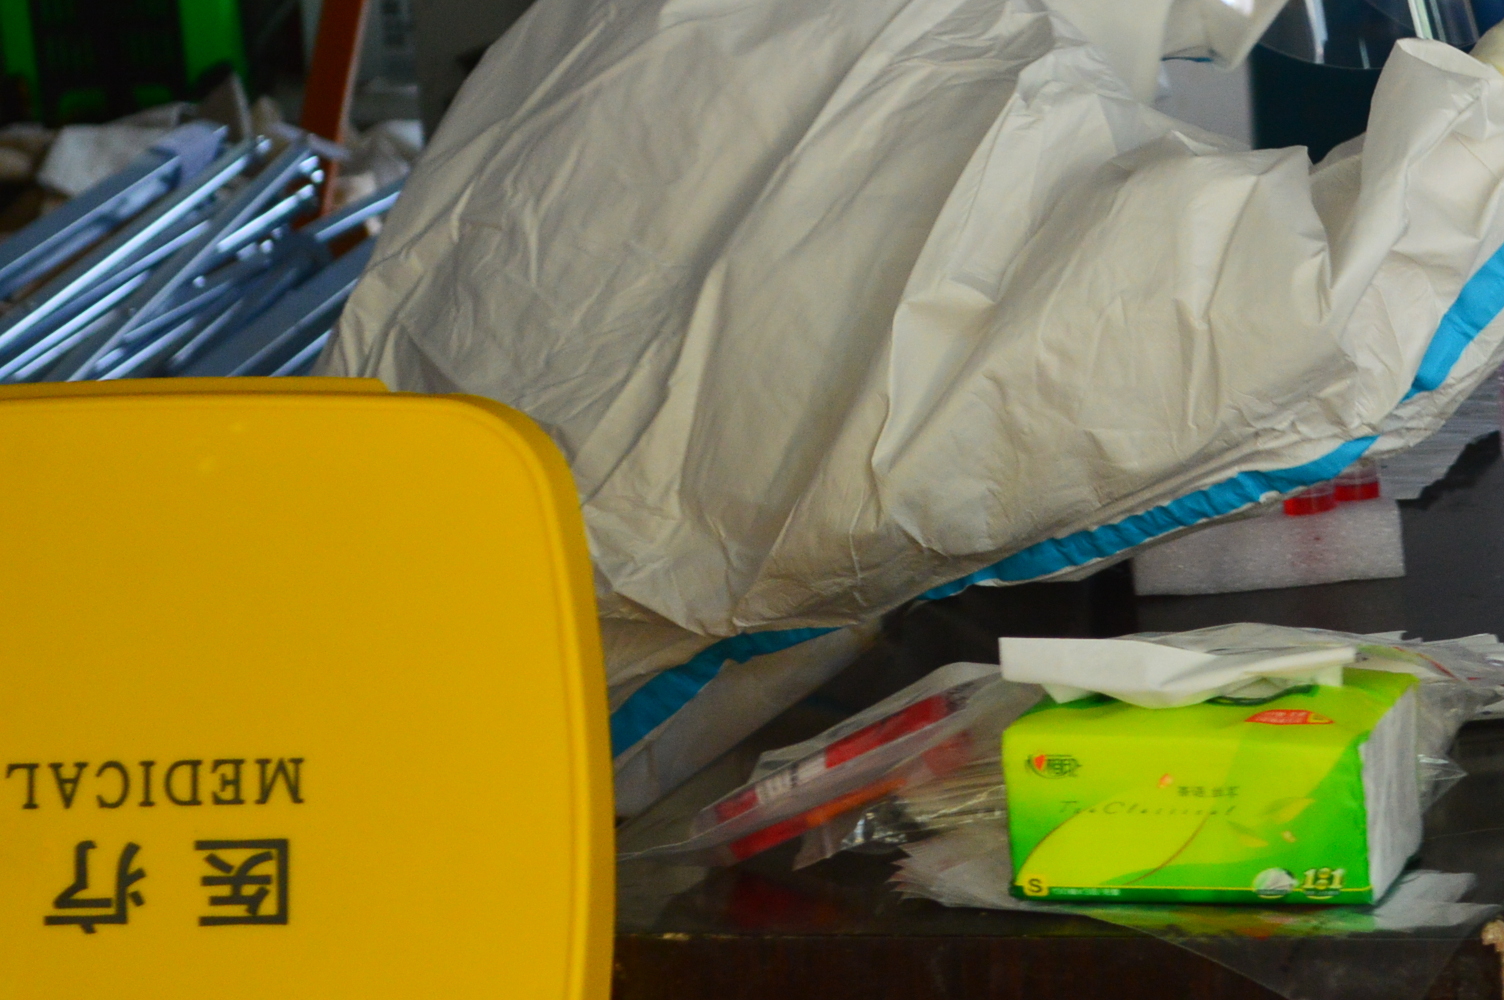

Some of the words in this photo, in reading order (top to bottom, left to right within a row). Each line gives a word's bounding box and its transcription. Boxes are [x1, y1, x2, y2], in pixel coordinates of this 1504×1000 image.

[5, 757, 305, 810] MEDICAL
[43, 838, 289, 935] 医疗
[1027, 878, 1043, 894] S
